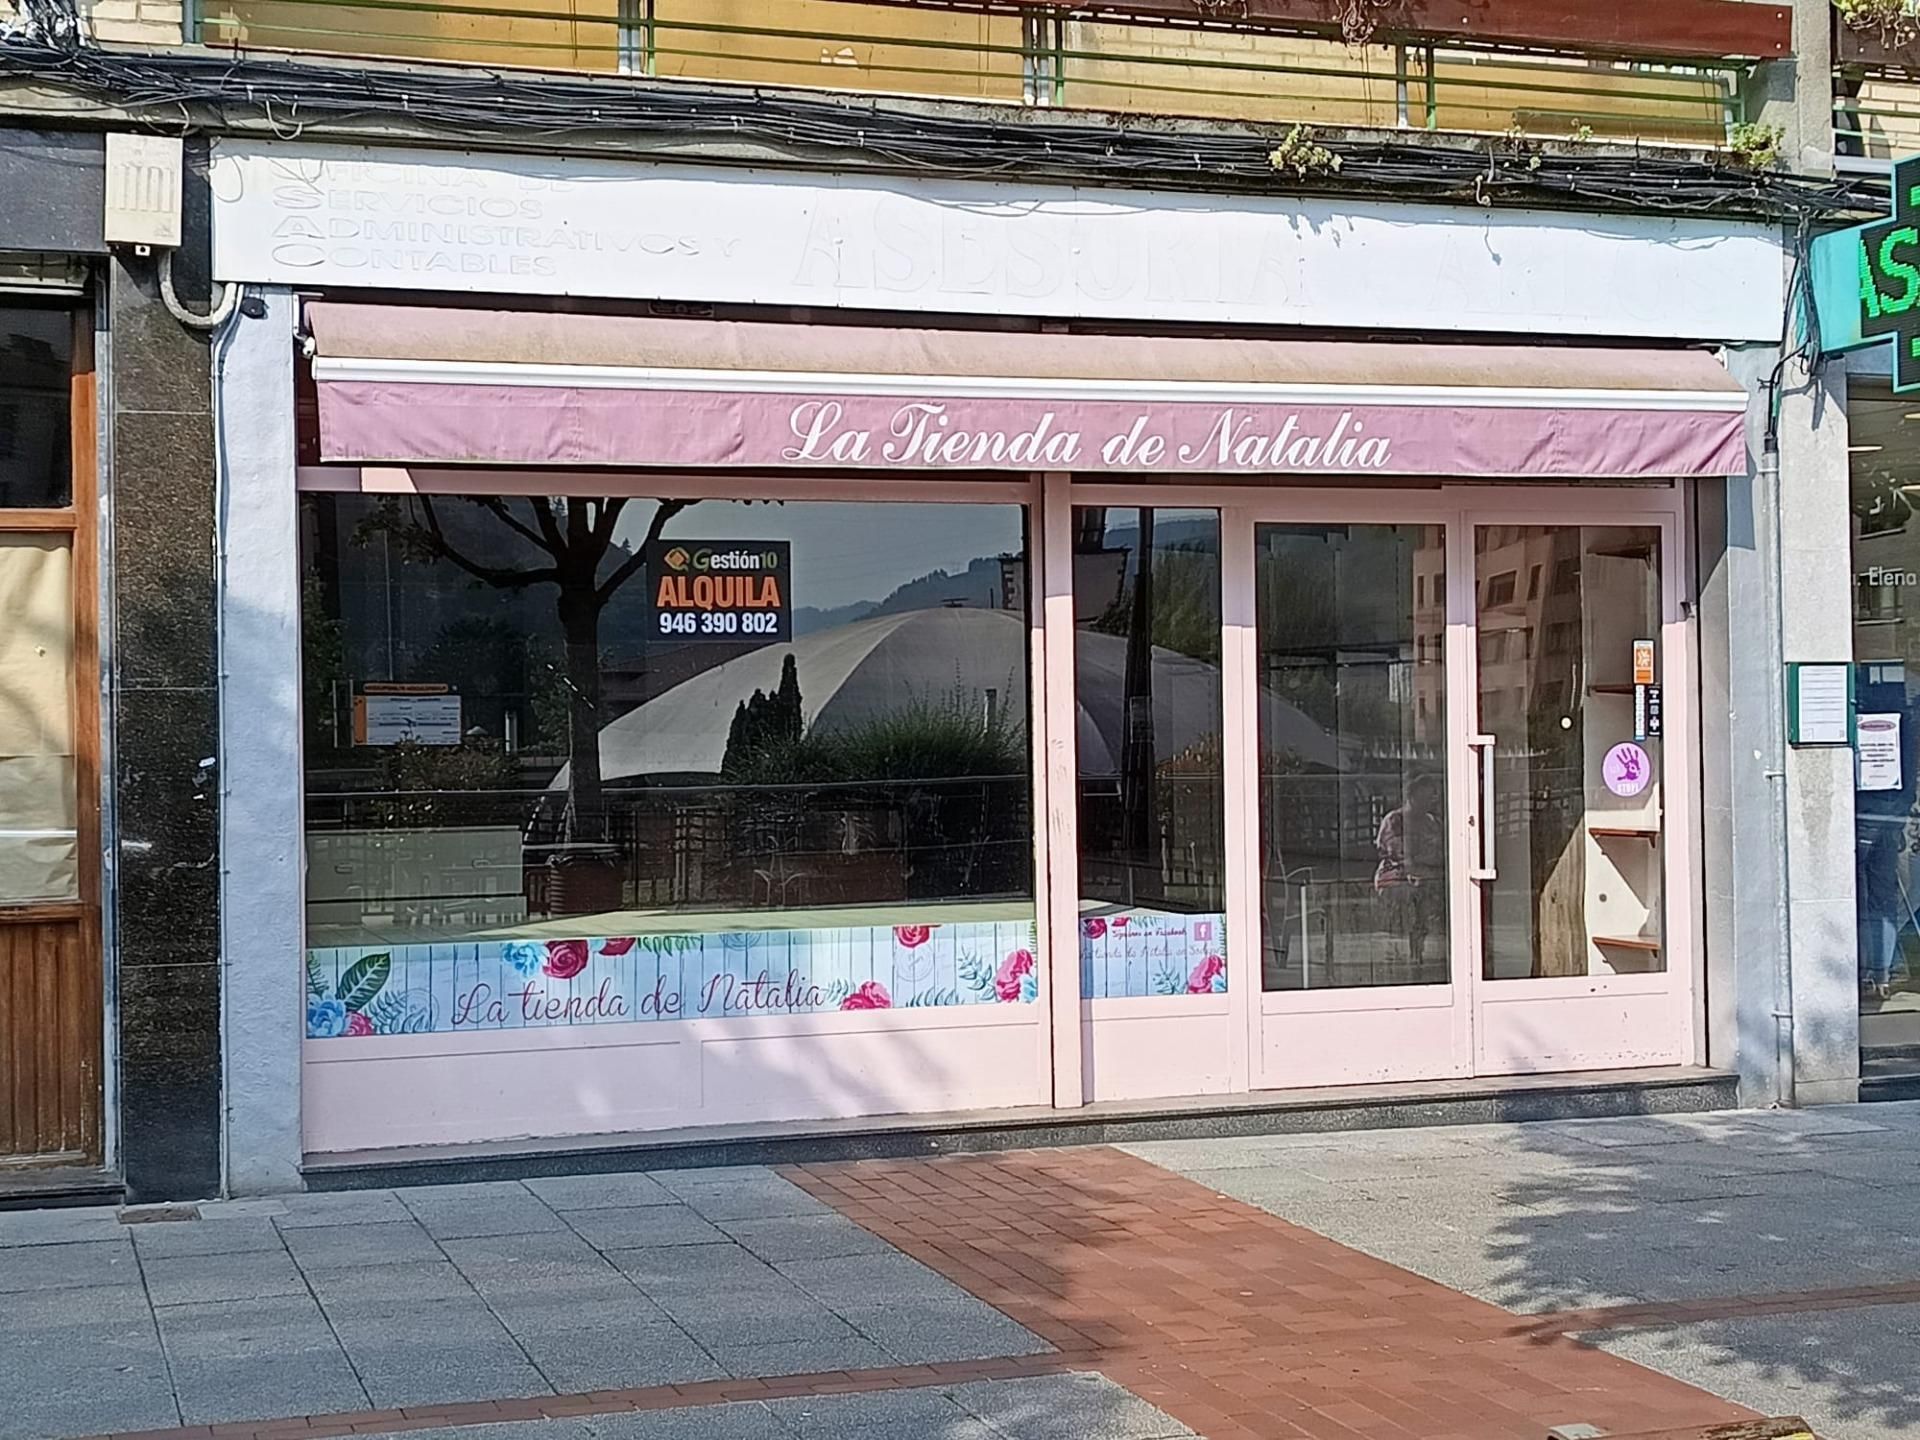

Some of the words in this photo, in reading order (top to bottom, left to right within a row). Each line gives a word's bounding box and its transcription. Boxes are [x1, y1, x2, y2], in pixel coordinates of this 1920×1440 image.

[271, 242, 557, 276] CONTABLES
[781, 400, 872, 463] La
[881, 402, 1083, 464] Tienda
[1100, 415, 1166, 466] de
[1178, 406, 1393, 468] Natalia
[693, 547, 778, 572] Gestión10
[1869, 565, 1917, 587] Elena
[656, 575, 781, 610] ALQUILA
[659, 612, 697, 633] 946
[701, 612, 737, 633] 390
[741, 612, 778, 633] 802
[450, 982, 509, 1026] La
[508, 976, 630, 1022] tienda
[640, 974, 684, 1015] de
[697, 968, 825, 1015] Natalia
